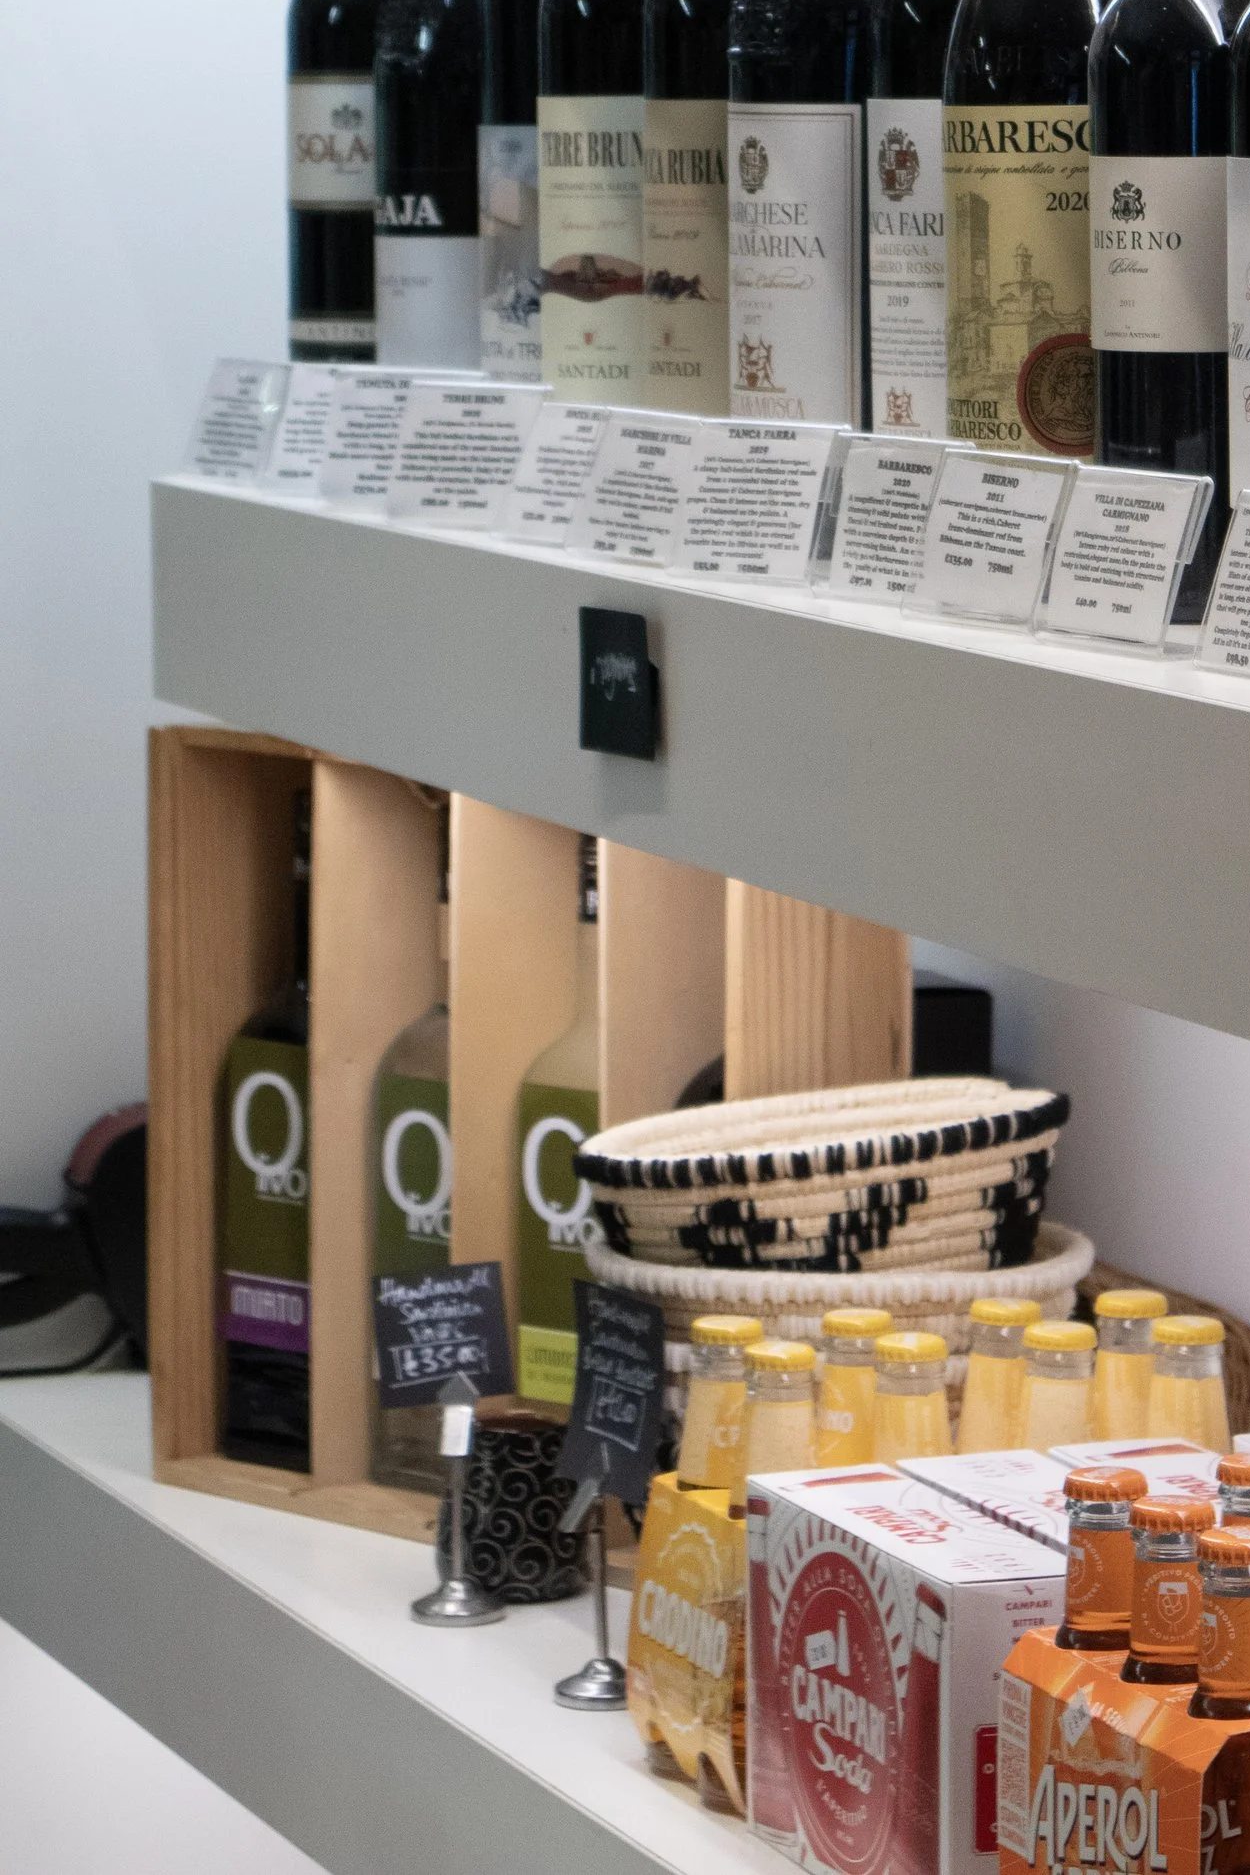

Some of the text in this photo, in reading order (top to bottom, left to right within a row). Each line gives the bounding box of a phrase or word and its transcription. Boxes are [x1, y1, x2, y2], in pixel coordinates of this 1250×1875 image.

[1094, 229, 1182, 251] BISERNO
[792, 1663, 887, 1765] CAMPARI
[810, 1719, 873, 1794] Soda
[1029, 1764, 1168, 1874] APEROL
